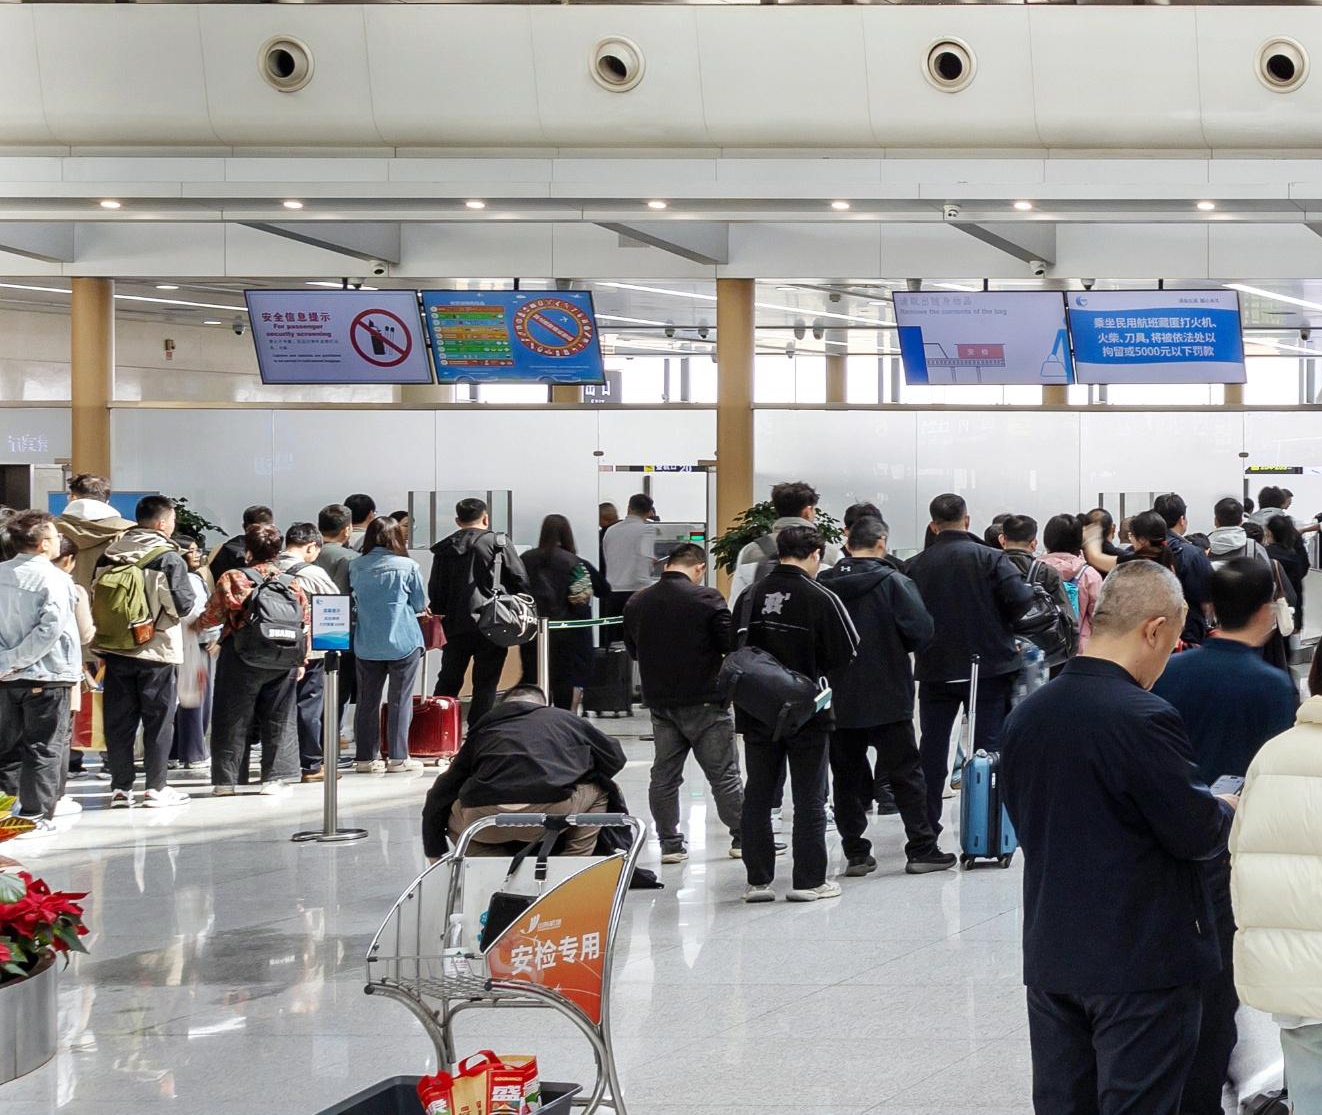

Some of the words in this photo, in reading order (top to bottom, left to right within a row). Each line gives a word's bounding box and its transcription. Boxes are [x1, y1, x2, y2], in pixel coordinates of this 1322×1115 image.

[262, 312, 331, 322] 安全信息提示
[1102, 346, 1215, 357] 拘留或5000元以下罚款
[511, 931, 600, 976] 安检专用
